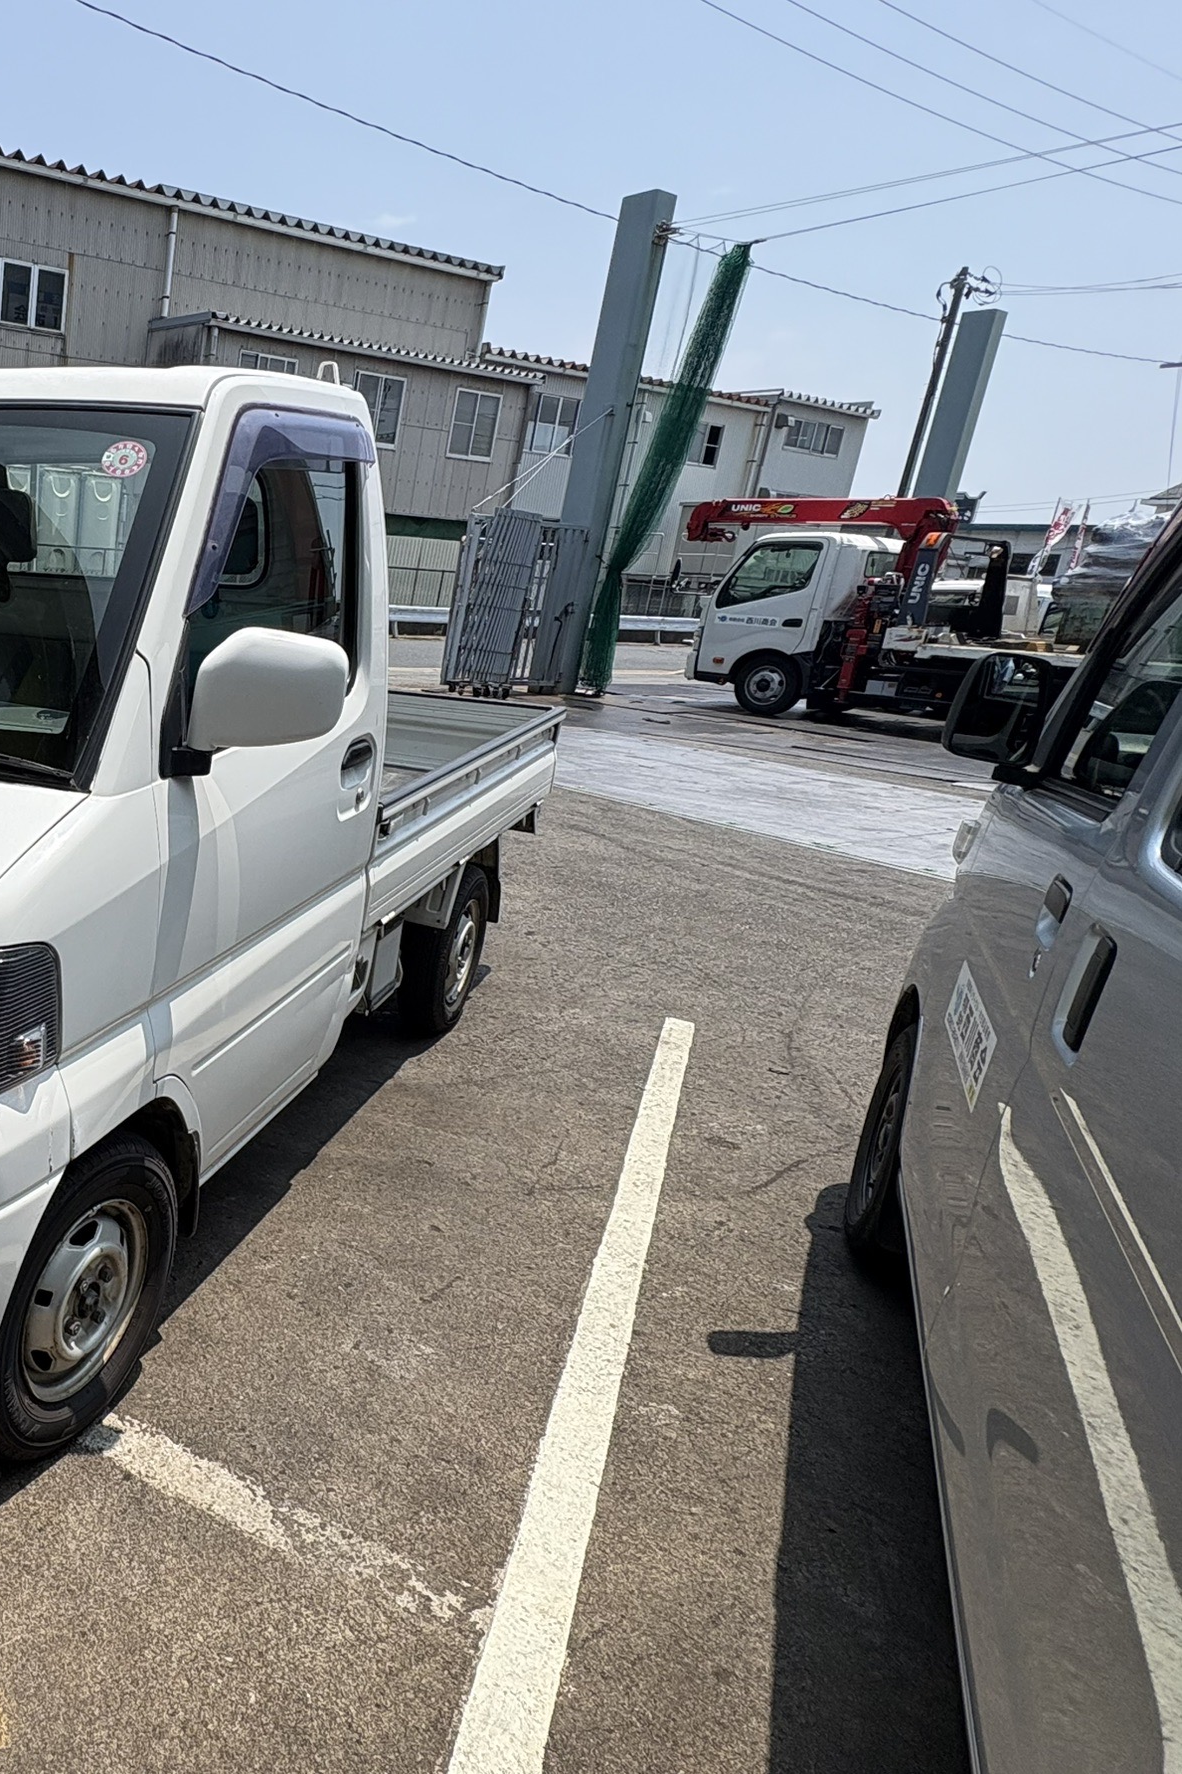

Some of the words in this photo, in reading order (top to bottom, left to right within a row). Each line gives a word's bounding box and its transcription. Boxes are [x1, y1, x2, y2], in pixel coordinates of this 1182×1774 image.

[119, 455, 129, 465] 6
[731, 503, 762, 512] UNIC
[907, 563, 930, 604] UNIC
